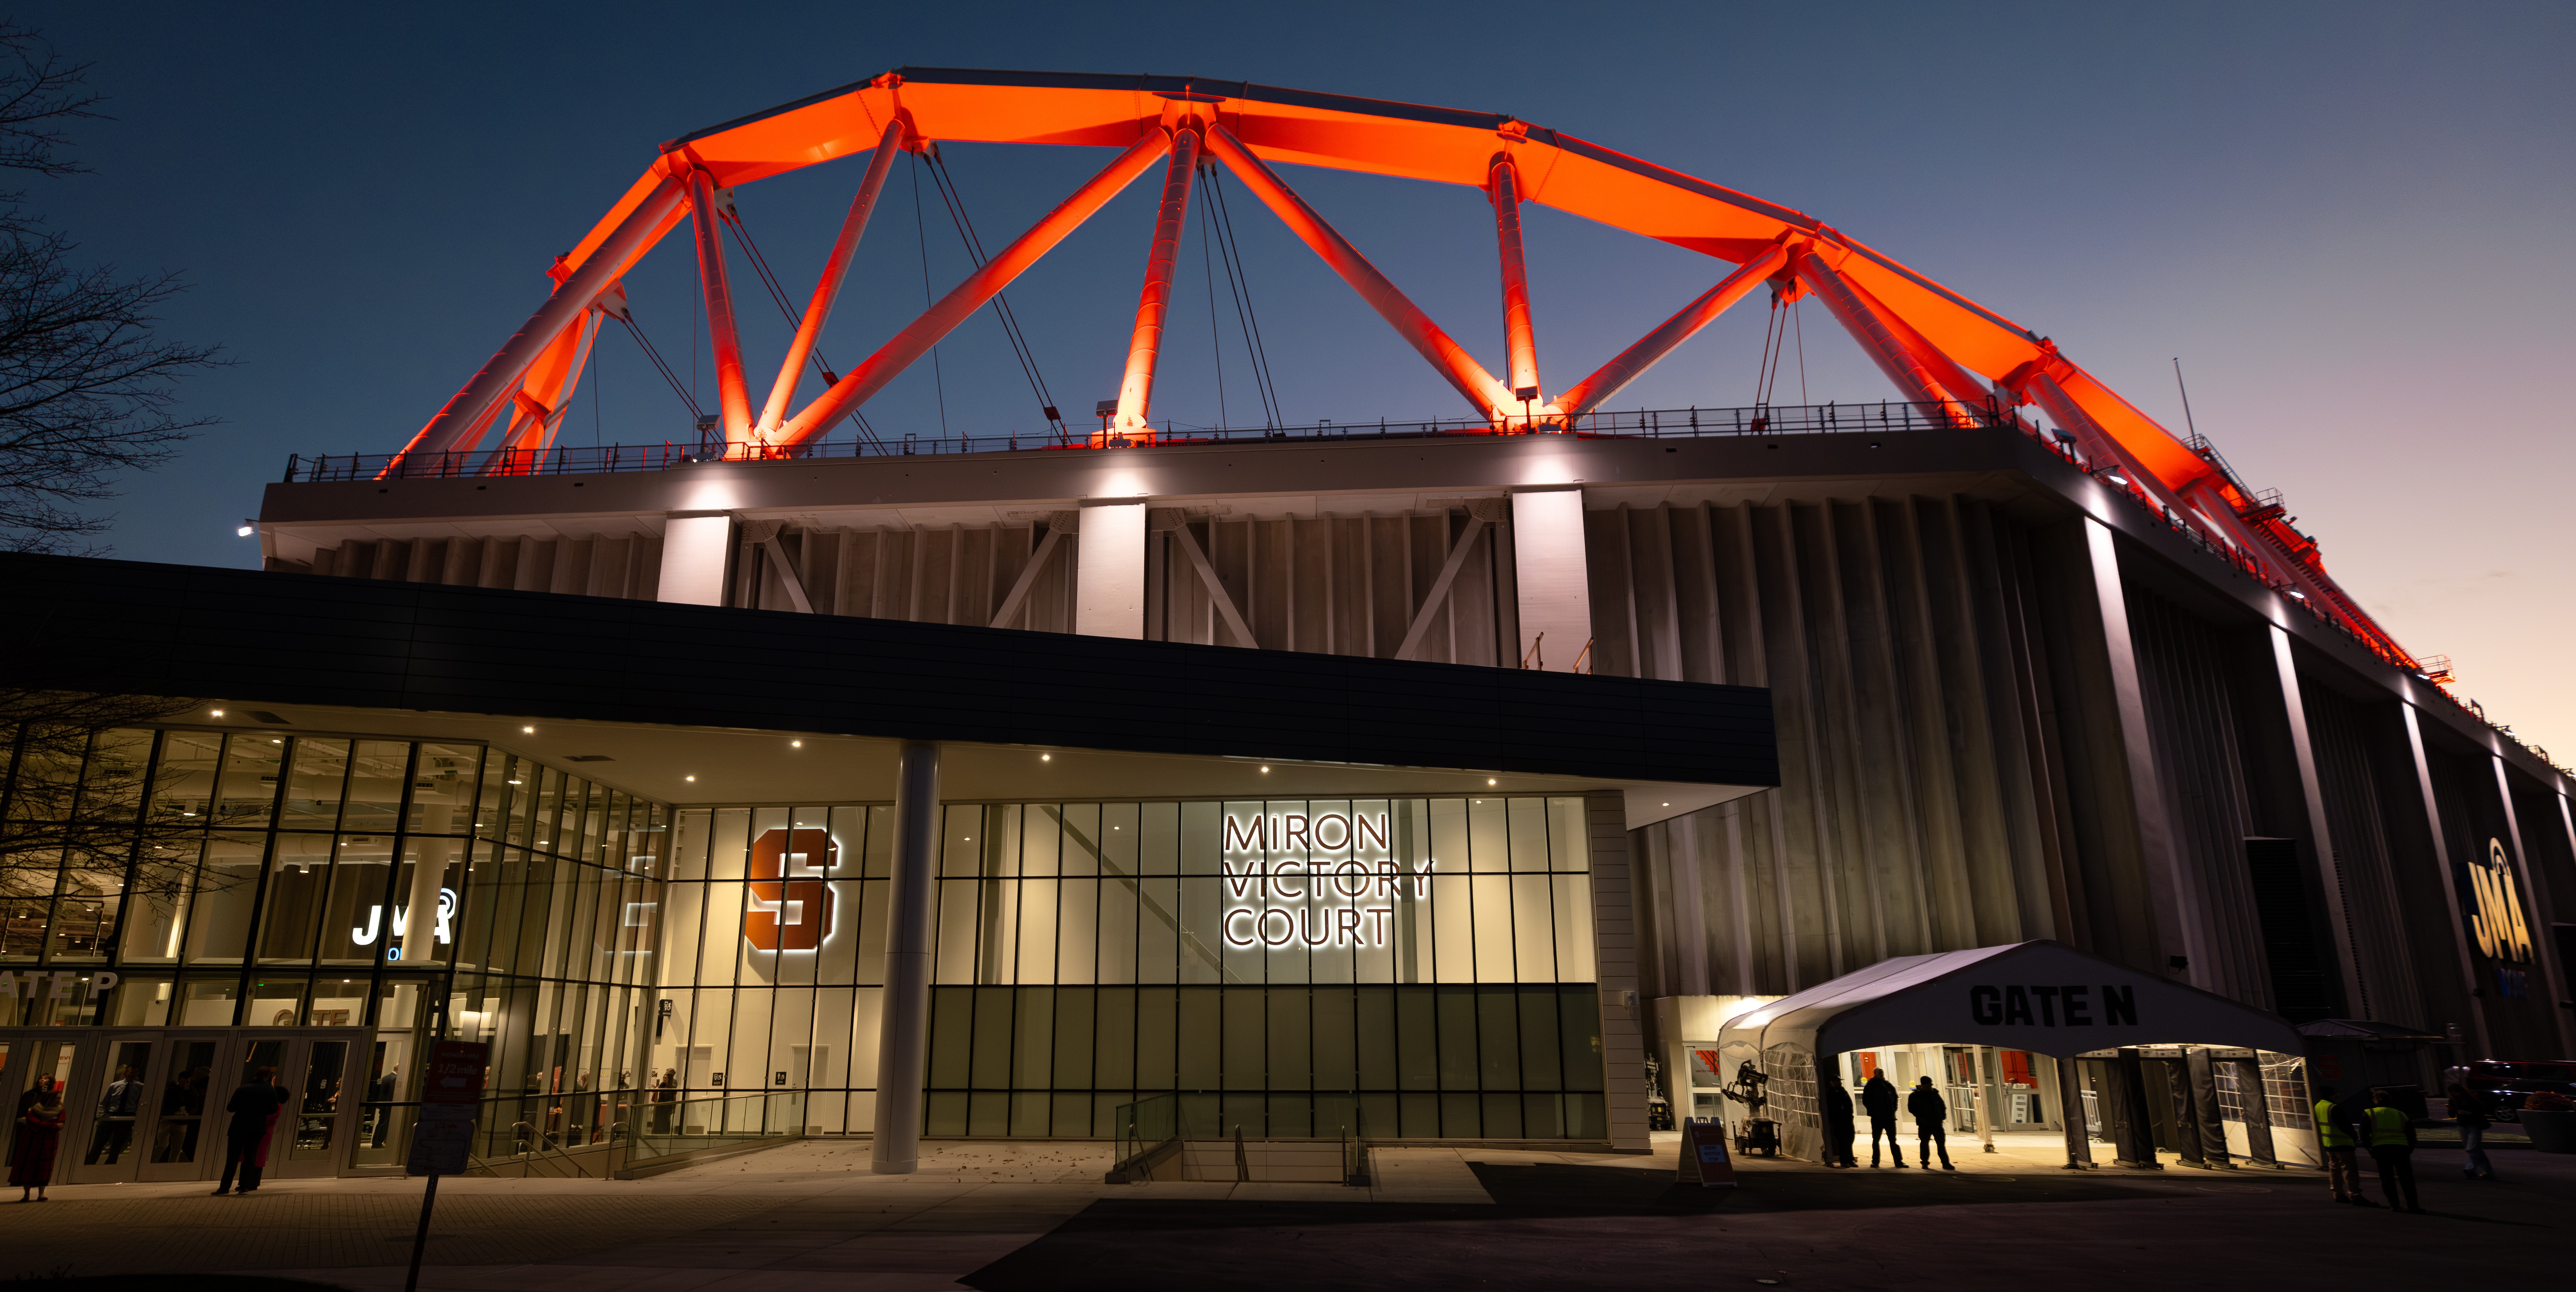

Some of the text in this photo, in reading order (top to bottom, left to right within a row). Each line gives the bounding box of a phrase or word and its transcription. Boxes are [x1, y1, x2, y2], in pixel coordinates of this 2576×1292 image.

[1225, 814, 1386, 850] MIRON
[745, 828, 838, 950] S
[1224, 861, 1434, 897] VICTORY
[1225, 909, 1391, 945] COURT
[2468, 861, 2535, 965] JMA
[89, 972, 117, 998] P
[1971, 985, 2138, 1027] GATE N
[438, 1063, 477, 1075] 1/2 mile
[2319, 1055, 2342, 1079] S
